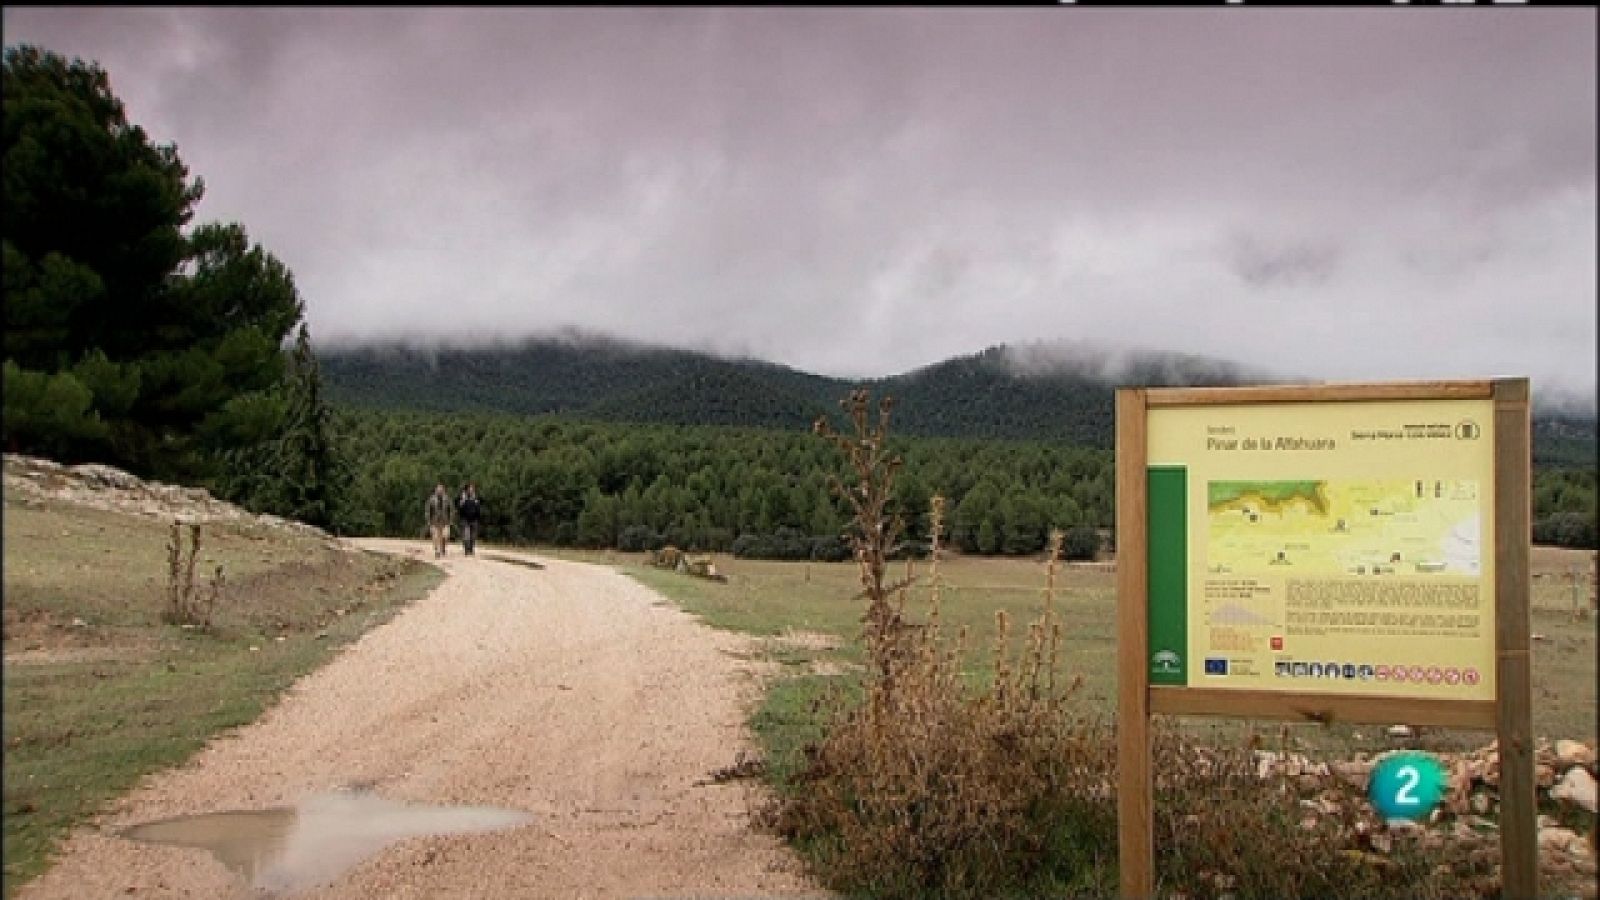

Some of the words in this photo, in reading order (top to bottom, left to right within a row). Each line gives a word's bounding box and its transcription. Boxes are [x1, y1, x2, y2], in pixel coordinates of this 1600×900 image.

[1207, 437, 1238, 451] Pinar
[1242, 437, 1258, 451] de
[1259, 437, 1272, 451] la
